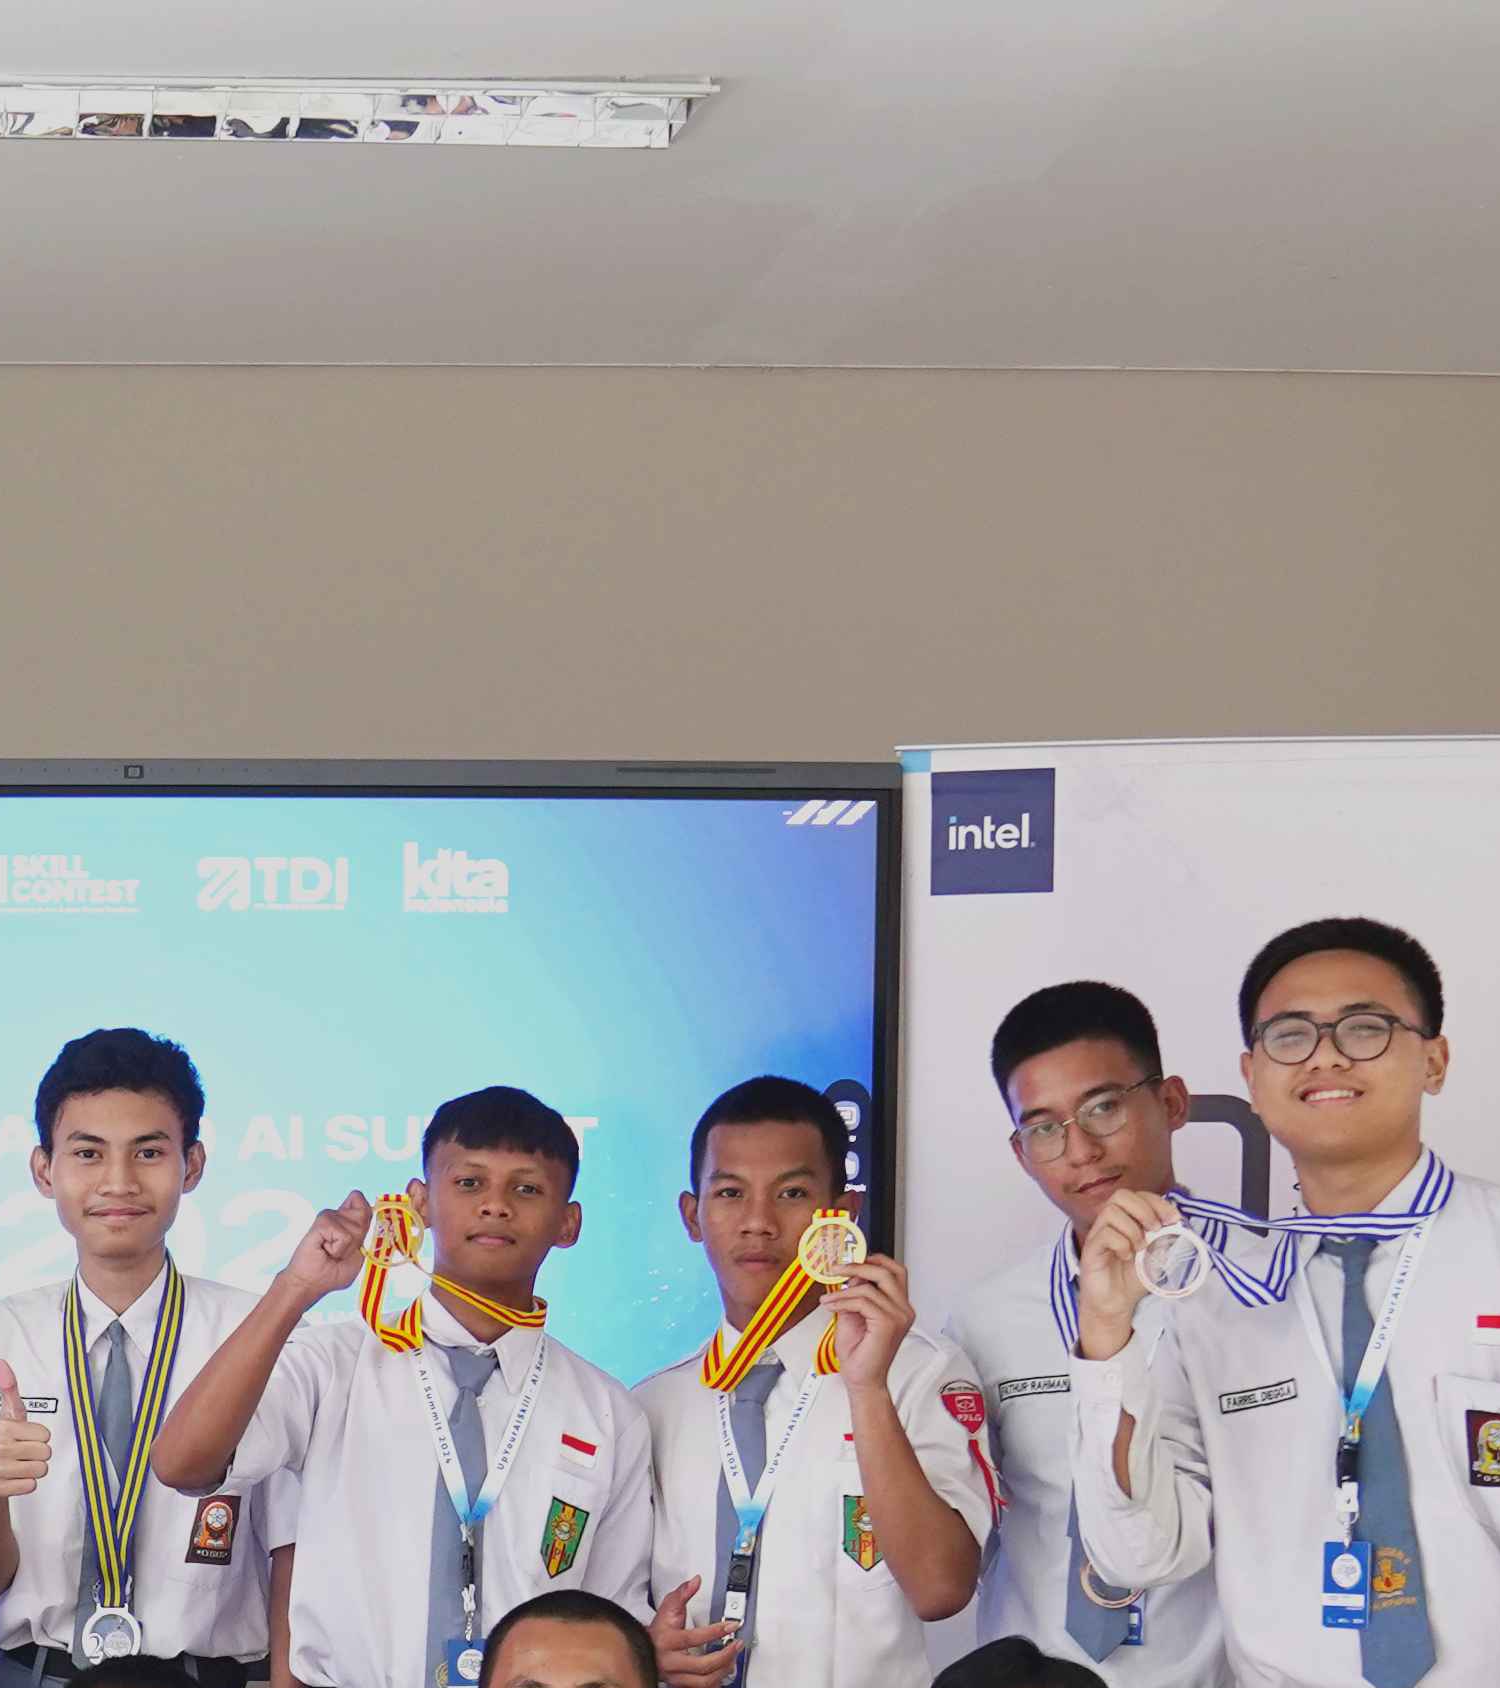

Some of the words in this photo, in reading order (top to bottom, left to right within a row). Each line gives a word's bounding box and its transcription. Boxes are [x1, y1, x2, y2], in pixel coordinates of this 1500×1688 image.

[948, 812, 1036, 852] intel
[11, 855, 89, 880] SKILL
[253, 857, 349, 903] TDI
[403, 842, 509, 898] kita
[11, 880, 141, 905] CONTEST
[239, 1115, 304, 1161] AI
[326, 1114, 599, 1162] SUT
[423, 1386, 442, 1432] Summit
[437, 1436, 453, 1465] 2024
[496, 1393, 532, 1471] UpYourAISkill
